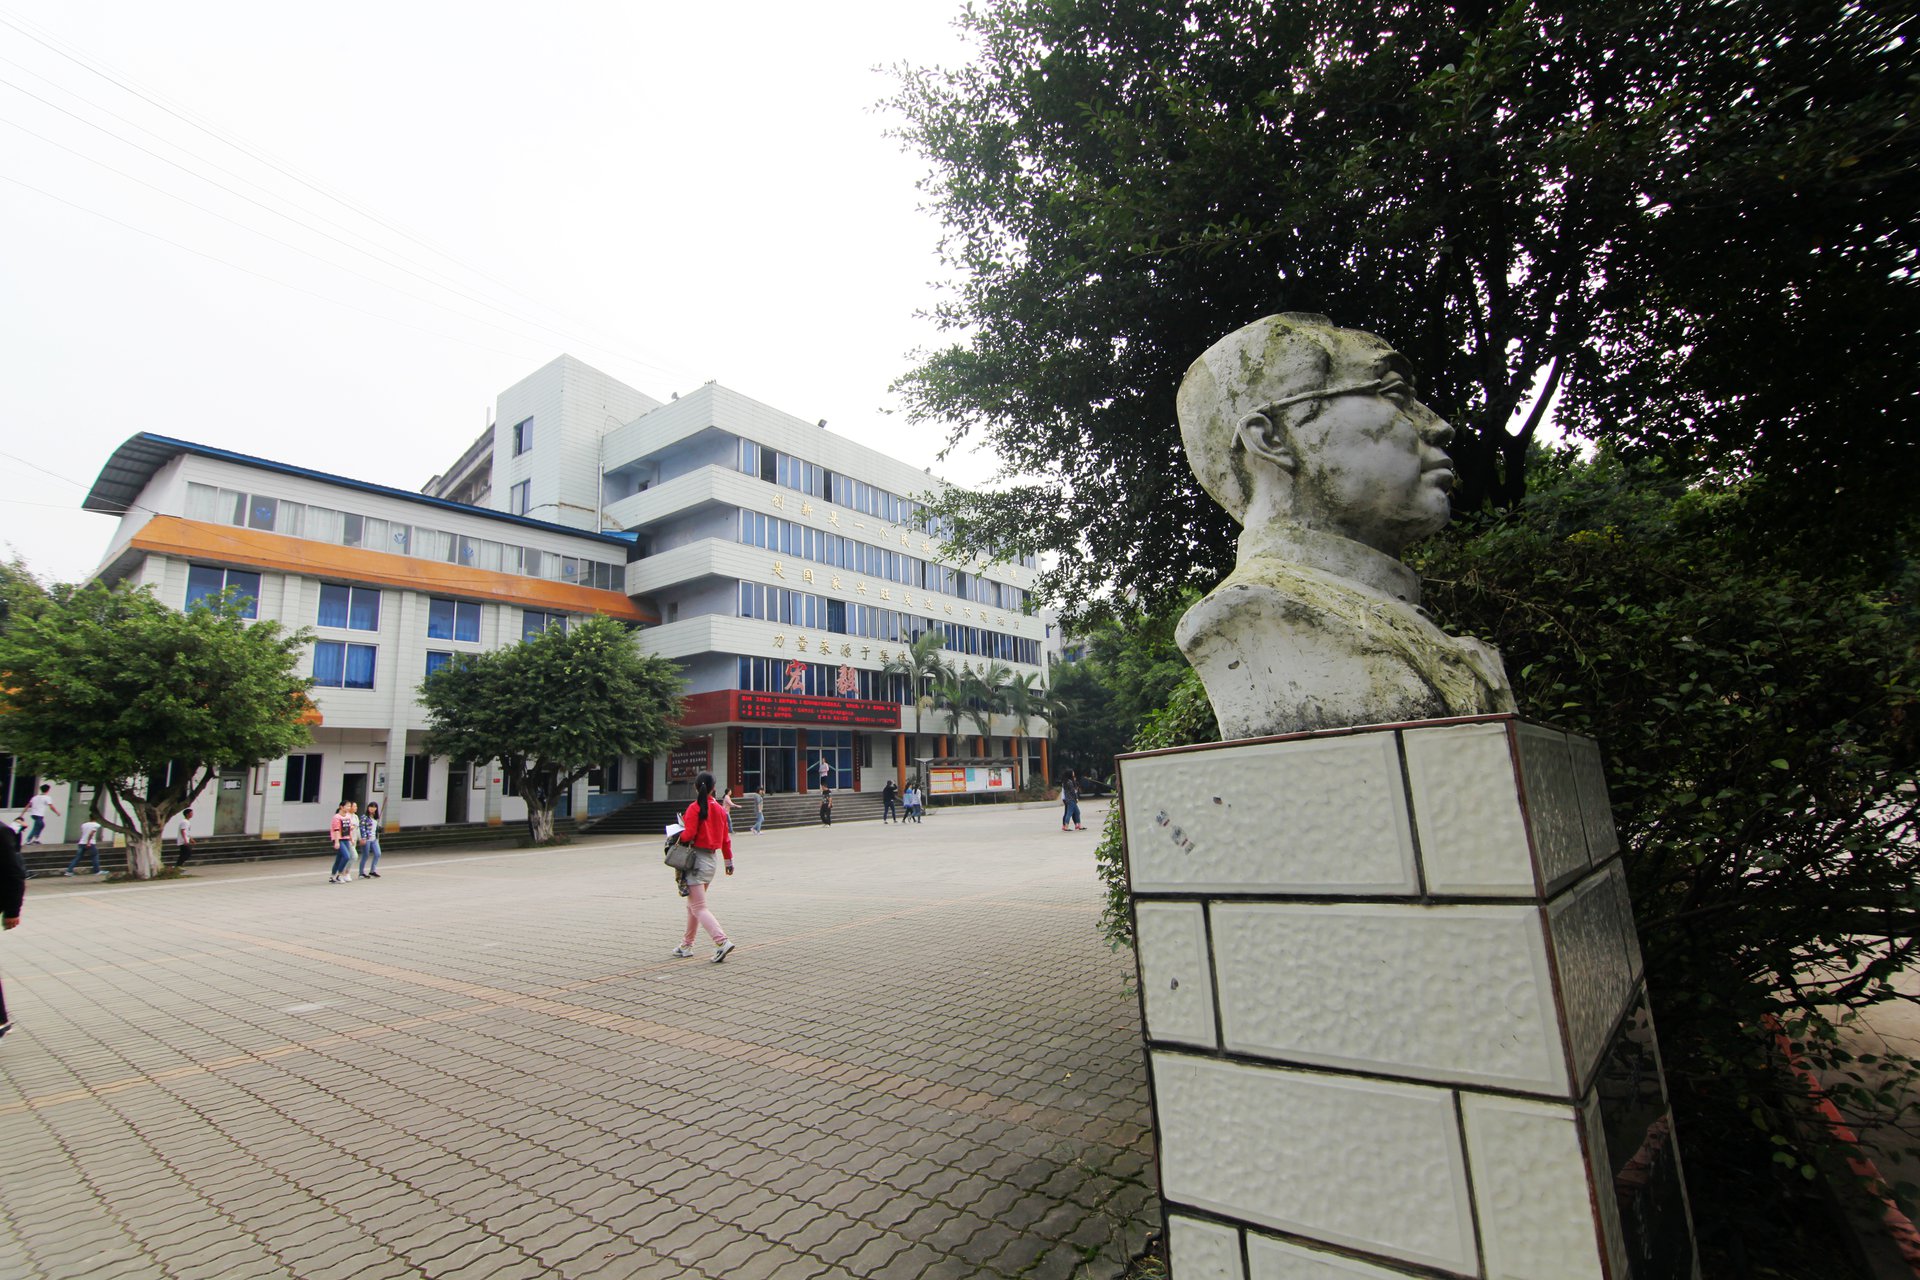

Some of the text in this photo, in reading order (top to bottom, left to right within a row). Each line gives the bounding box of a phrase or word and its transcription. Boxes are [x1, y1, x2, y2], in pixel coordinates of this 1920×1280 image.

[771, 493, 1017, 581] 创新是一个民族步的灵魂
[784, 658, 860, 695] 宏毅
